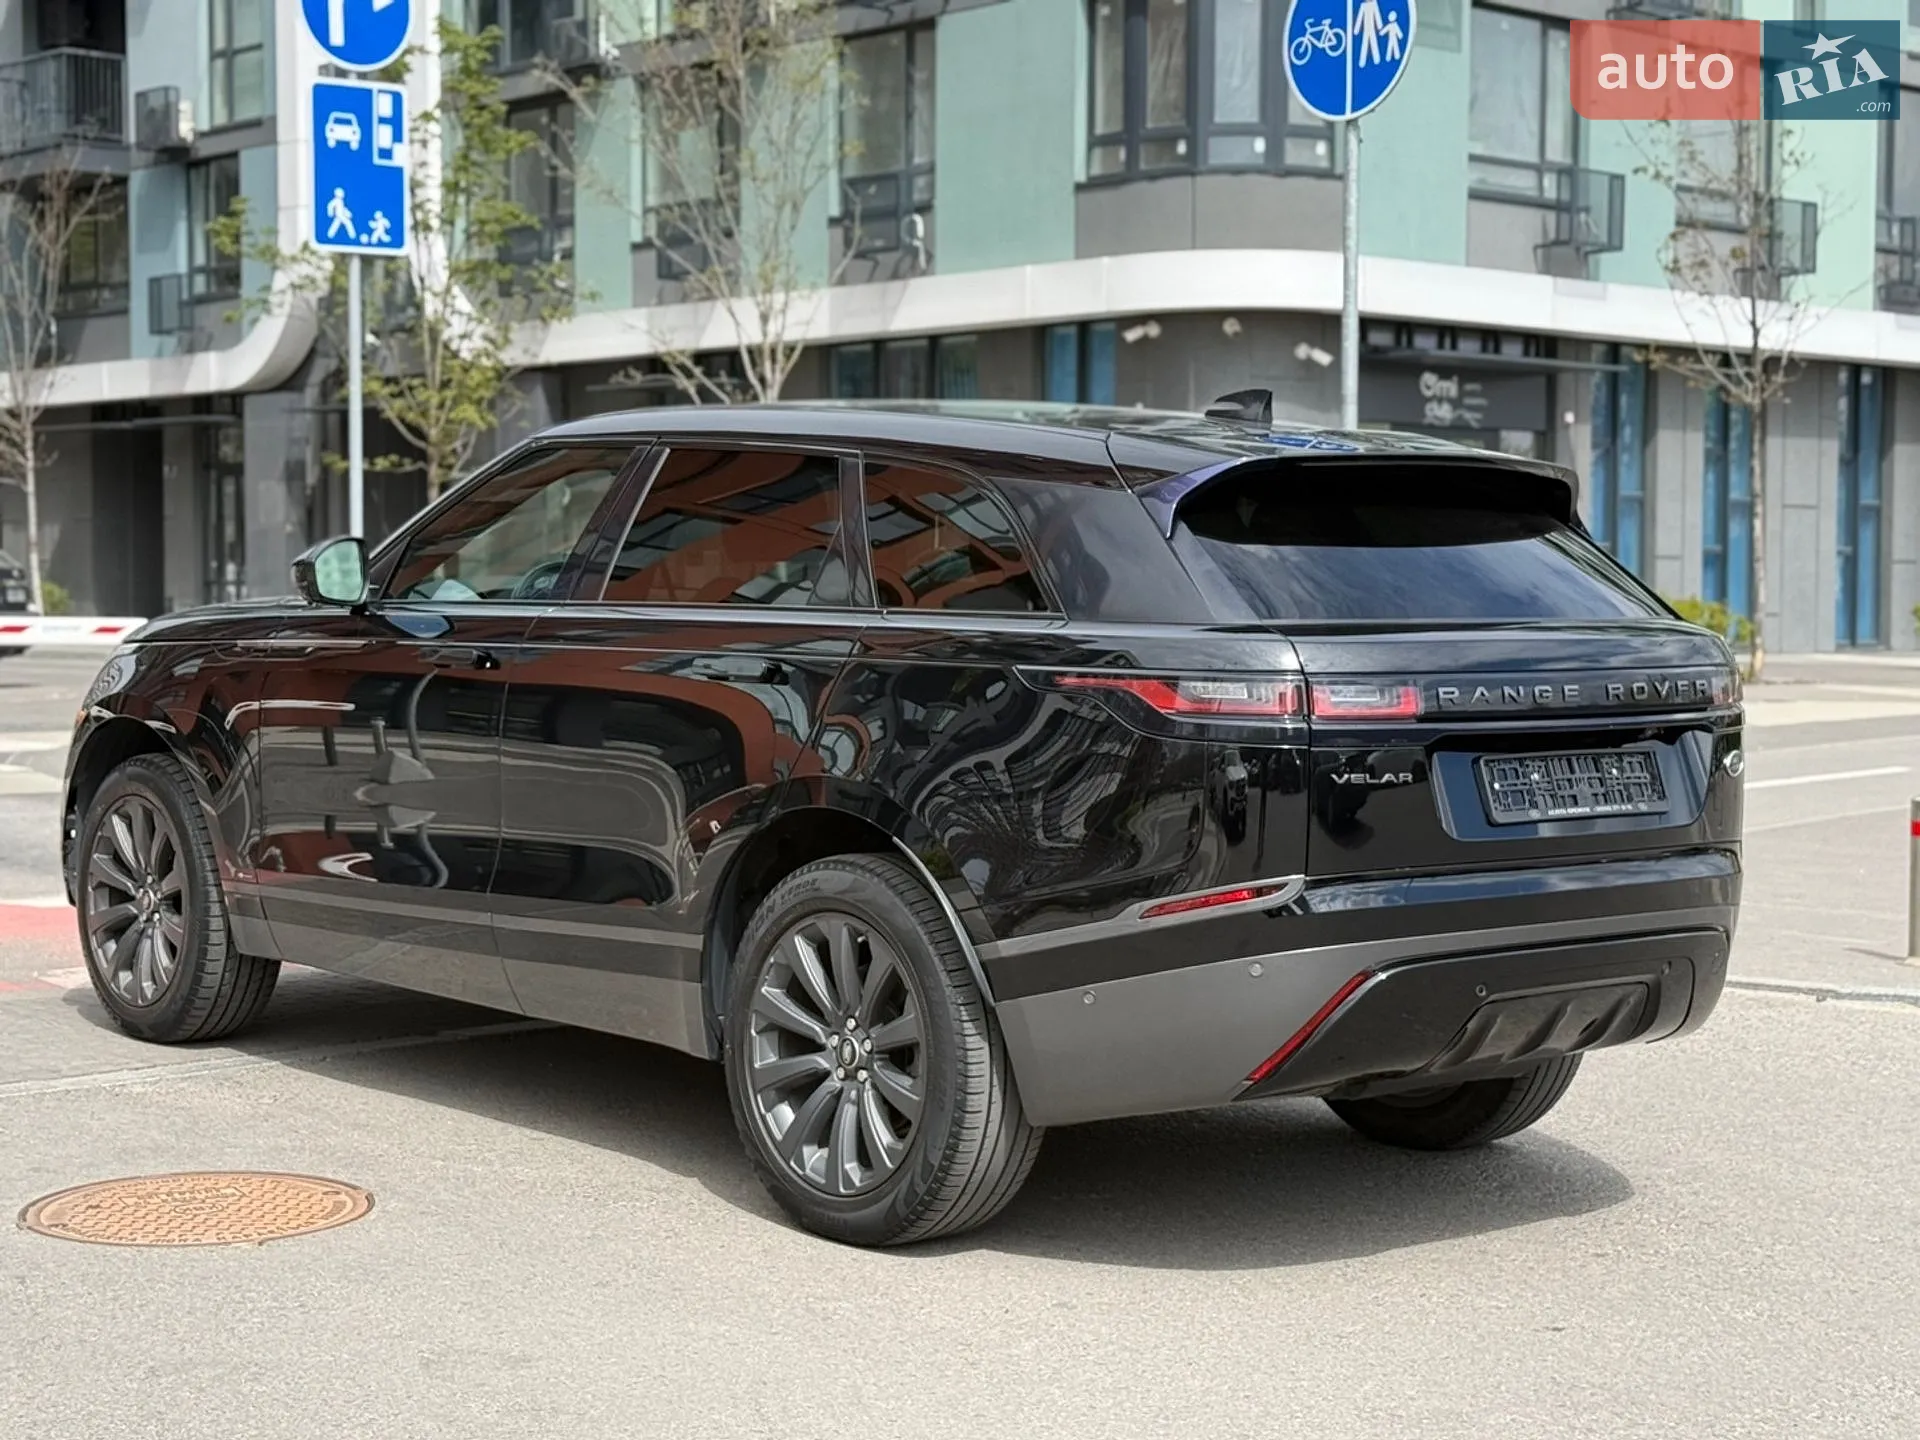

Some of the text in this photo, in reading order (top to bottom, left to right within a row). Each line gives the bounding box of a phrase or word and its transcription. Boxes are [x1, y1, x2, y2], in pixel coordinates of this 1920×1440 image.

[1437, 680, 1709, 708] RANGE ROVER
[1330, 773, 1413, 784] VELAR
